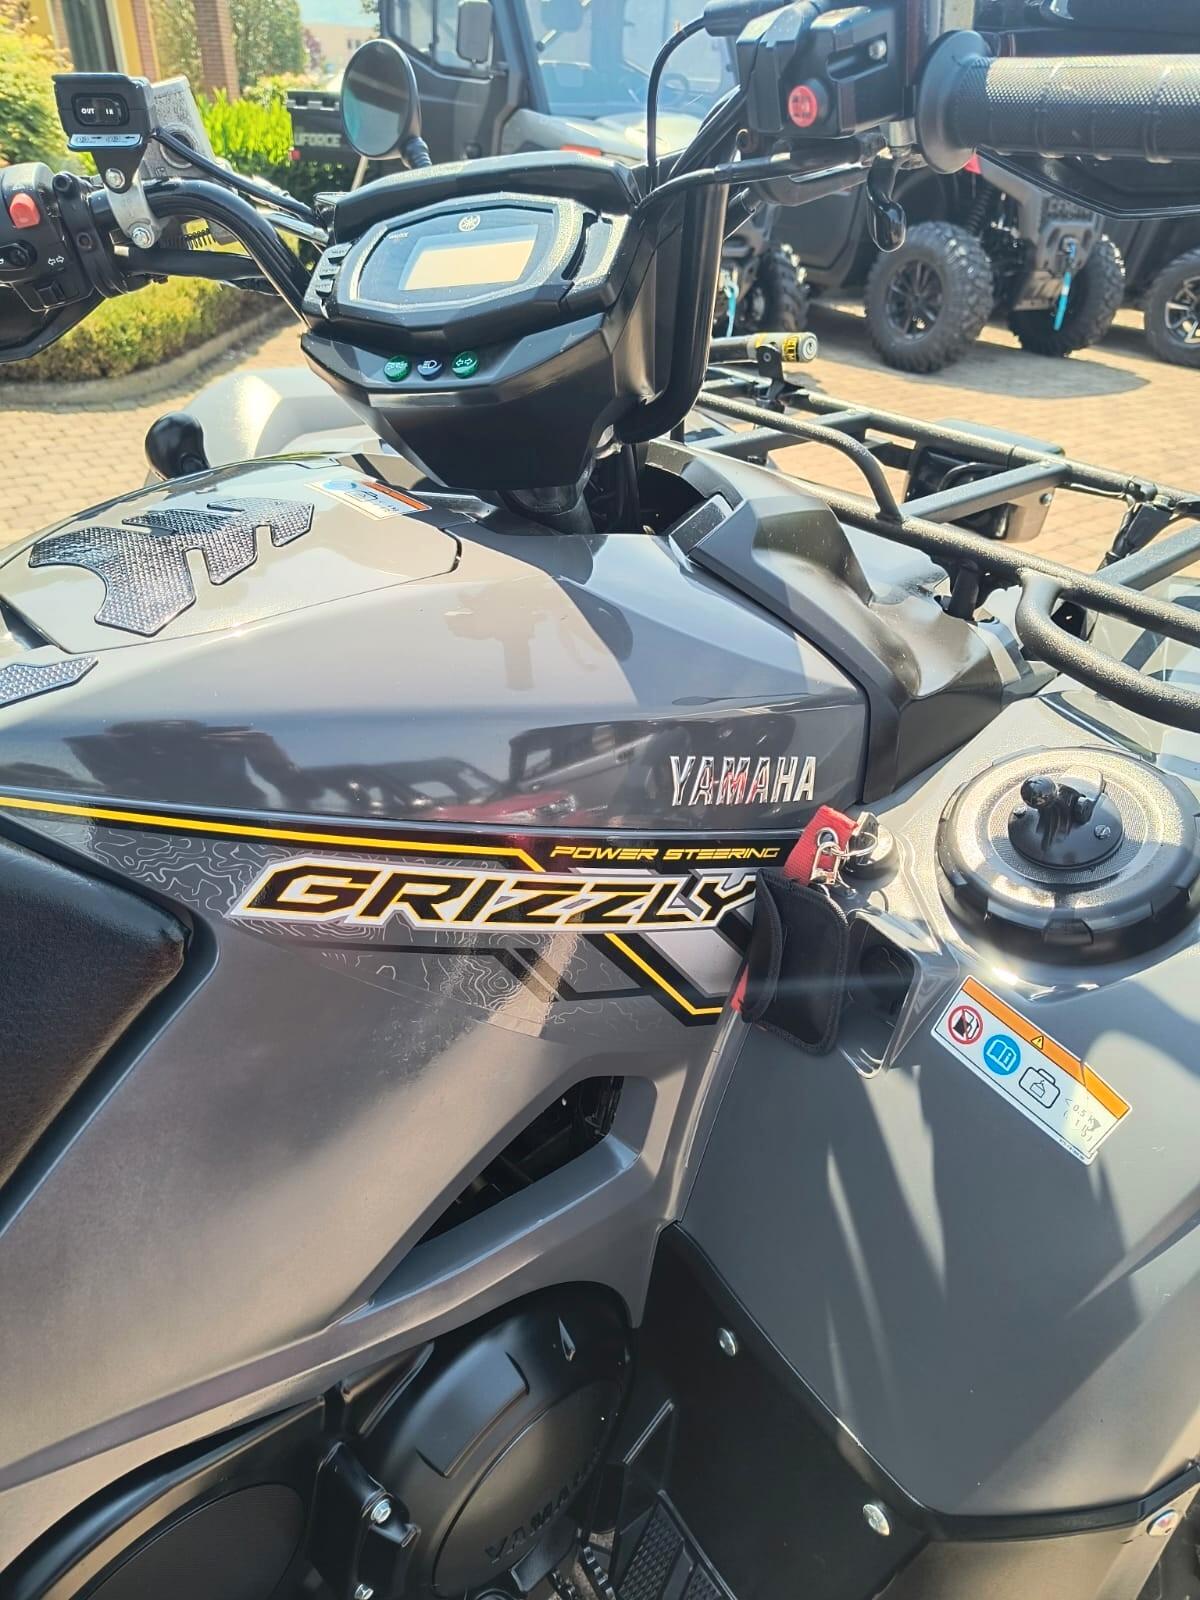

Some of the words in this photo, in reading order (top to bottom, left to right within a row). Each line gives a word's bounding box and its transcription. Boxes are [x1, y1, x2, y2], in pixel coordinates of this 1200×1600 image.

[80, 107, 95, 115] OUT
[669, 755, 817, 807] YAMAHA
[551, 845, 659, 861] POWER
[662, 847, 781, 861] STEERING
[234, 858, 757, 930] GRIZZLY
[1072, 1103, 1088, 1118] 0.5
